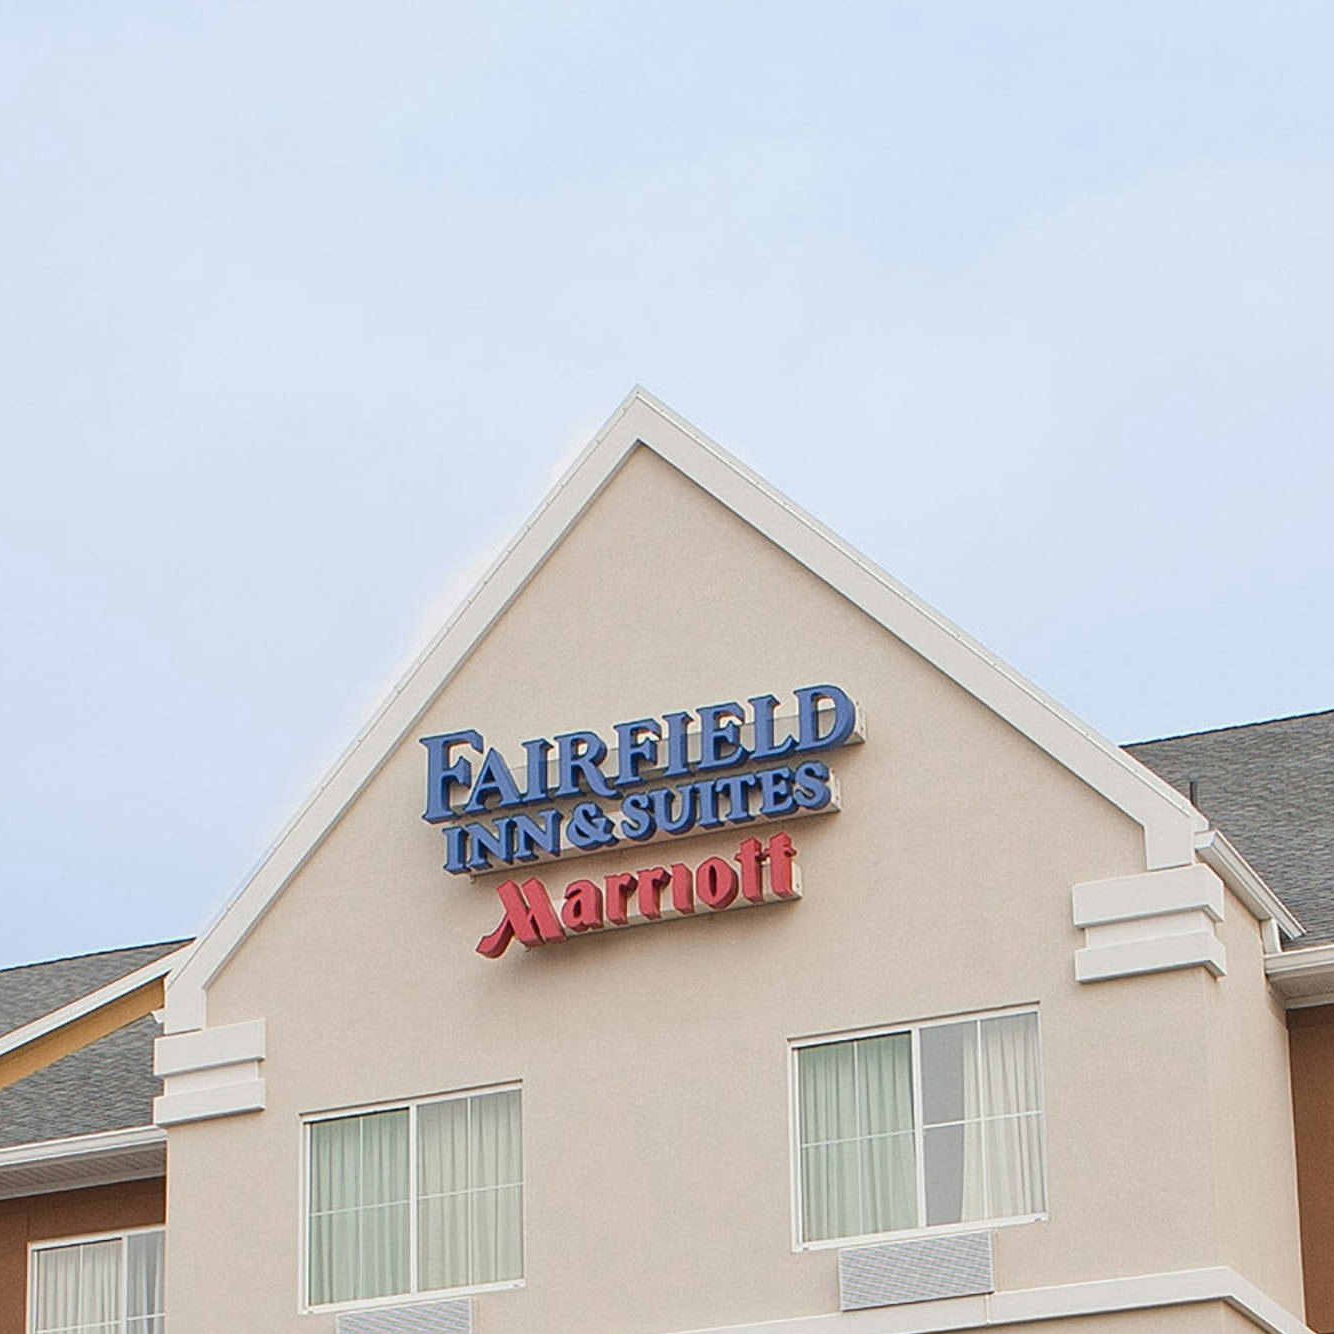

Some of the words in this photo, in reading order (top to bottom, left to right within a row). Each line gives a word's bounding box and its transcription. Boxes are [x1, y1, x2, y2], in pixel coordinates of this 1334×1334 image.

[419, 684, 856, 823] FAIRFIELD
[442, 809, 562, 875] INN
[566, 801, 619, 850] &
[621, 760, 832, 835] SUITES
[475, 831, 797, 959] Marriott
